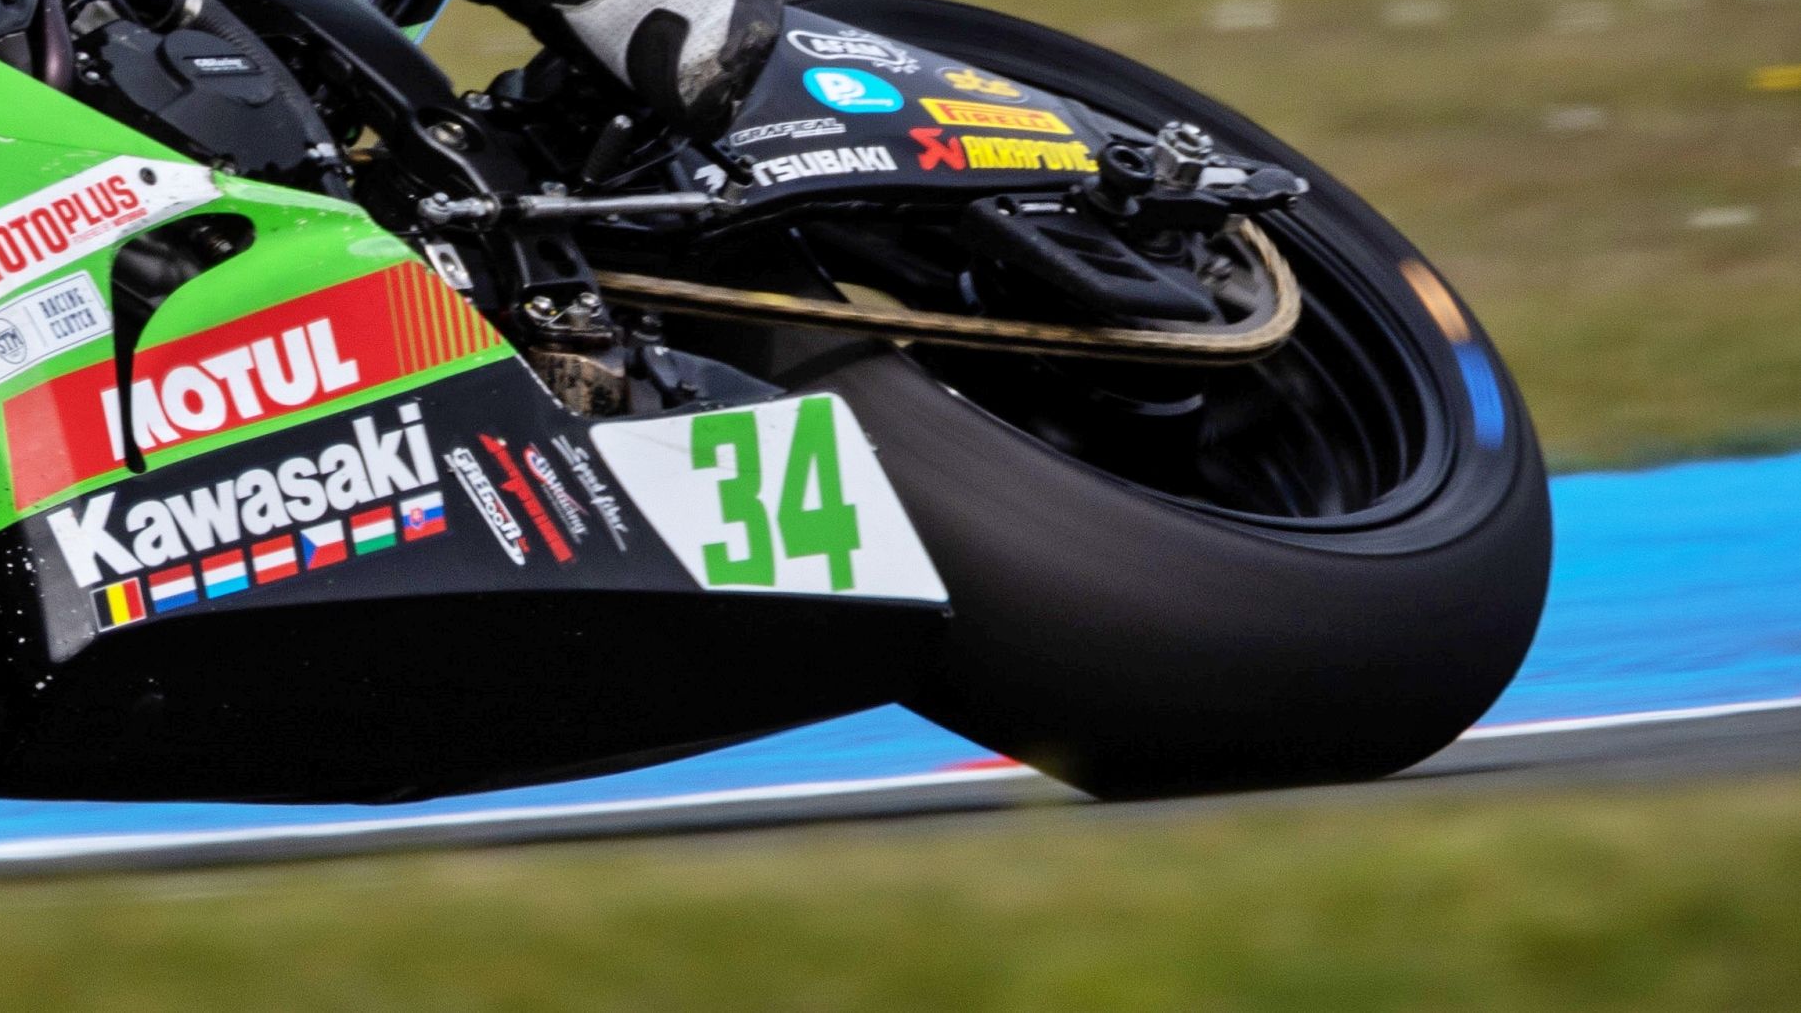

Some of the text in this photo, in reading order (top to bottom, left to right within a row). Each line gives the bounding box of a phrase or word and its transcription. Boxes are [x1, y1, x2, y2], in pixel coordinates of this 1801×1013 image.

[936, 102, 1062, 132] PIRELLI
[751, 146, 898, 187] TSUBAKI
[39, 287, 86, 319] RACING
[49, 307, 98, 340] CLUTCH
[100, 317, 361, 463] MOTUL
[45, 401, 440, 588] Kawasaki
[689, 396, 861, 593] 34
